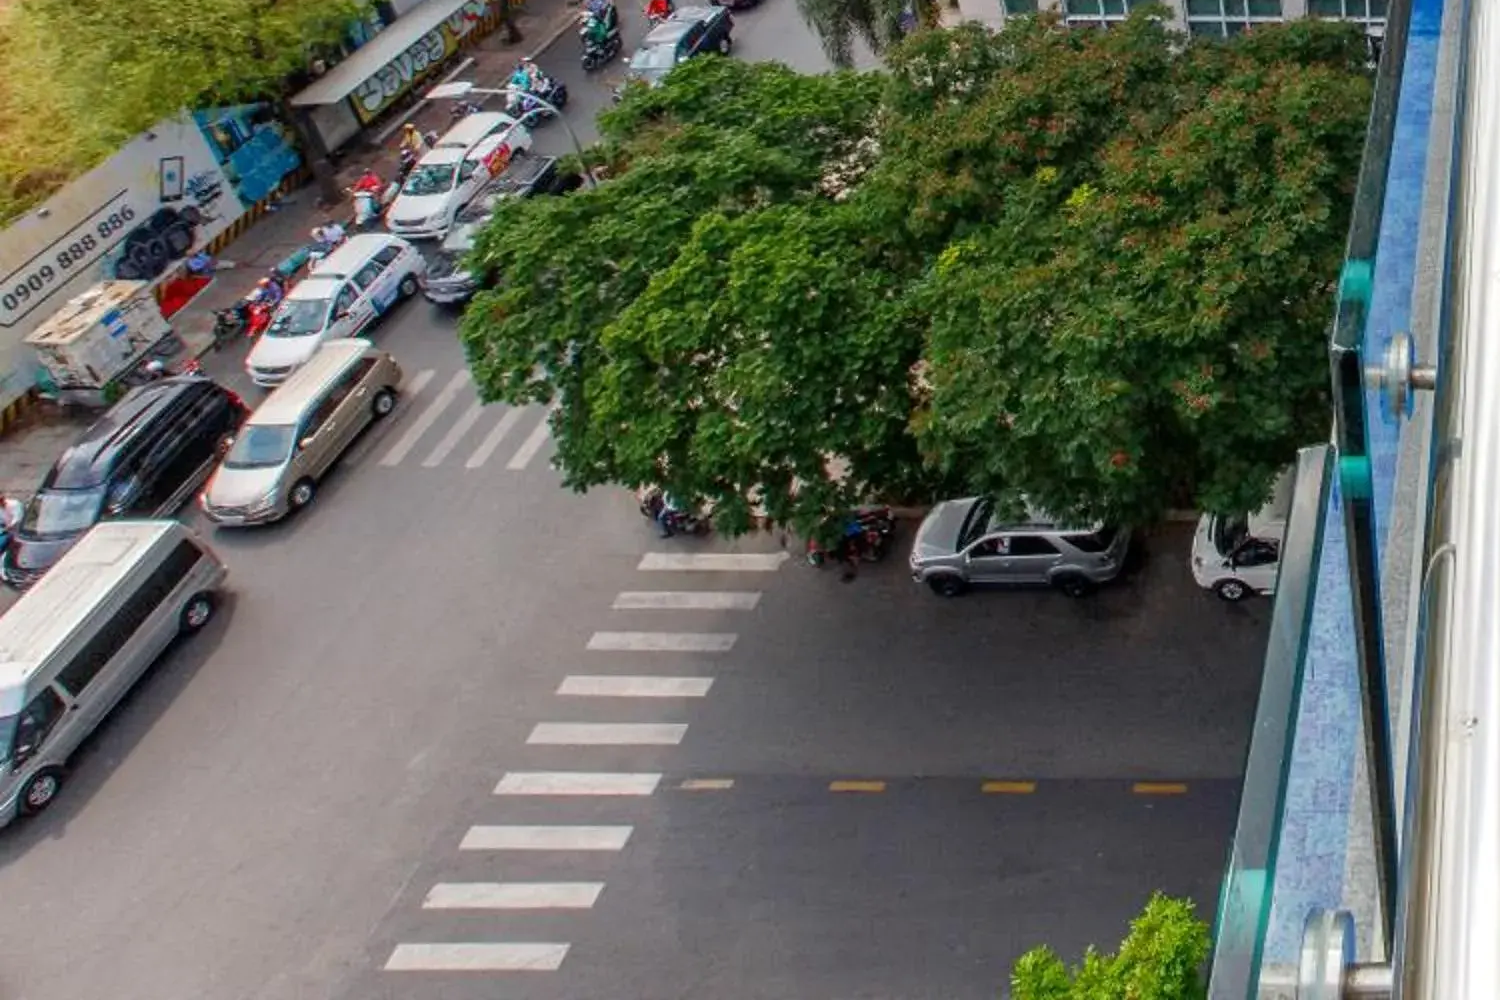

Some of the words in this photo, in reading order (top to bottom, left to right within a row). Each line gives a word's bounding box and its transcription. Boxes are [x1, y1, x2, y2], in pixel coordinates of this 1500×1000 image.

[2, 265, 55, 310] 0909
[56, 234, 98, 269] 888
[97, 204, 136, 239] 886
